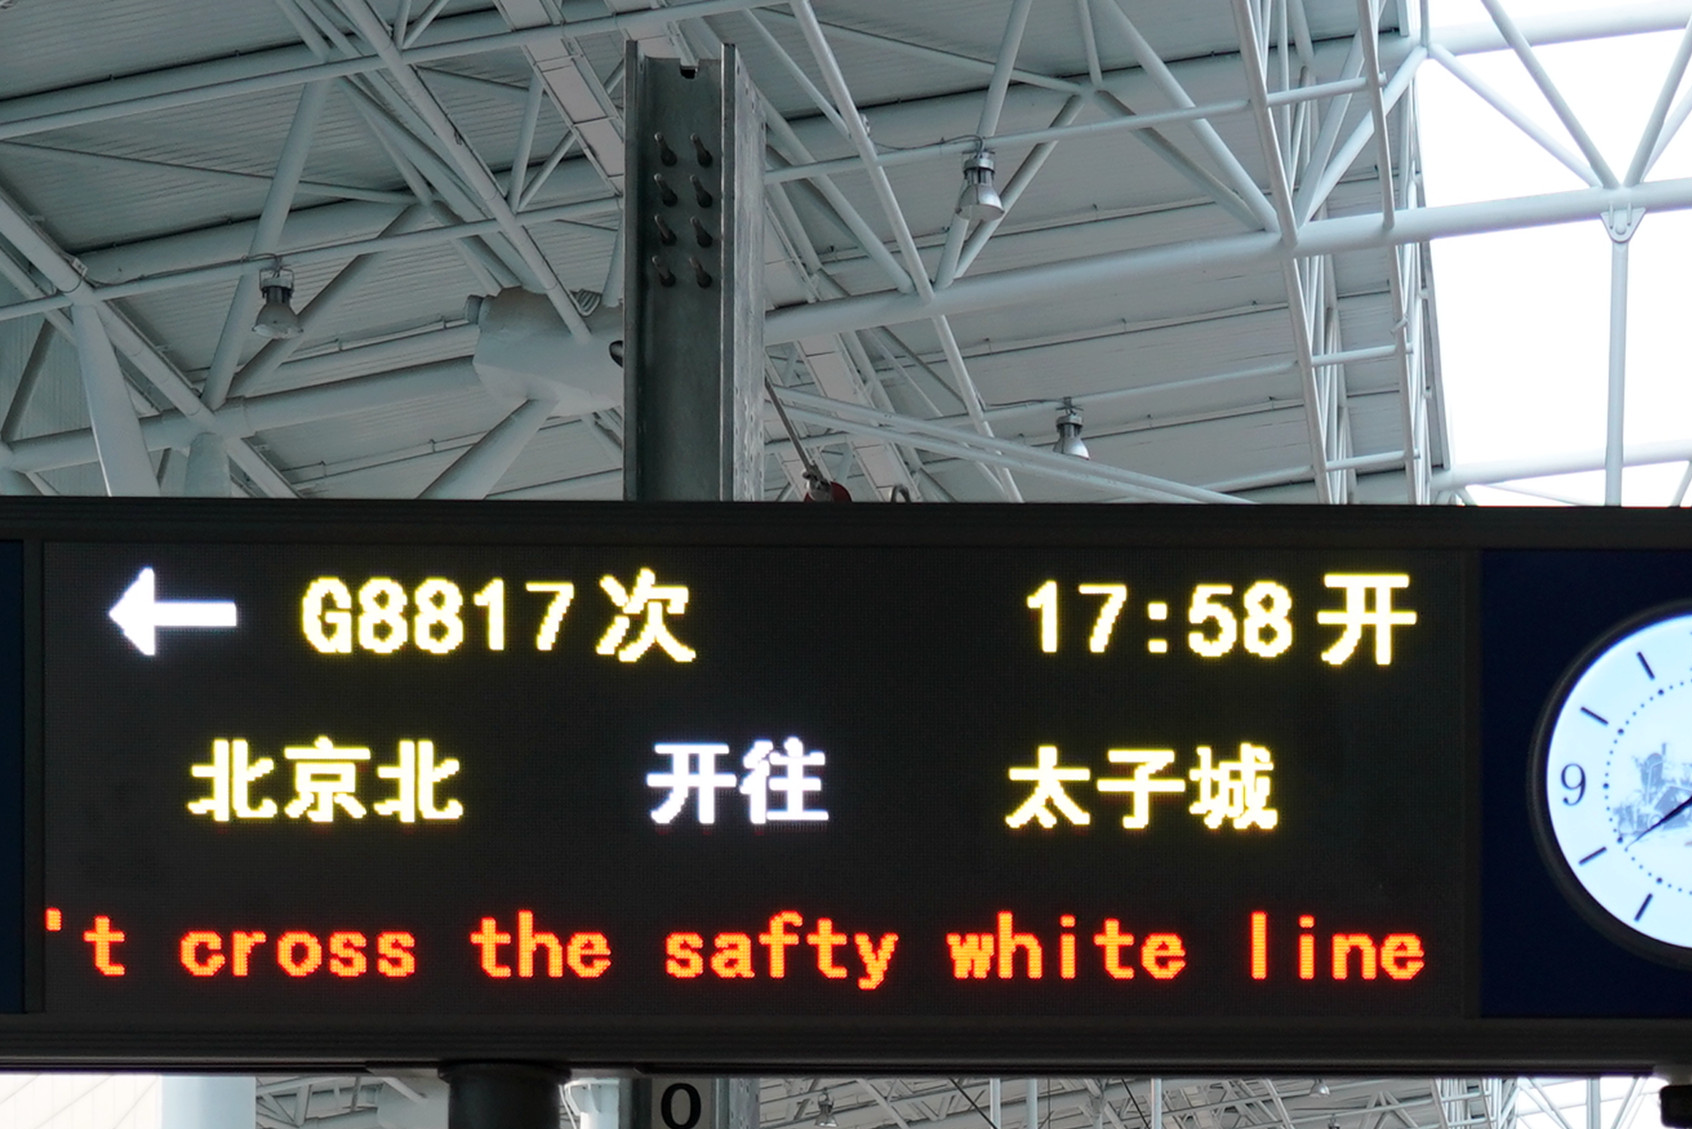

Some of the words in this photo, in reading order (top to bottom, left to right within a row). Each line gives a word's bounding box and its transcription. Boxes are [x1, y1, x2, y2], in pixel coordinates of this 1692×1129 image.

[188, 736, 465, 824] 北京北
[646, 736, 830, 825] 开往
[1006, 742, 1279, 831] 太子城
[1561, 764, 1587, 805] 9
[181, 931, 417, 978] cross
[471, 910, 612, 979] the
[666, 910, 899, 991] safty
[947, 911, 1187, 981] white
[1252, 911, 1425, 981] line
